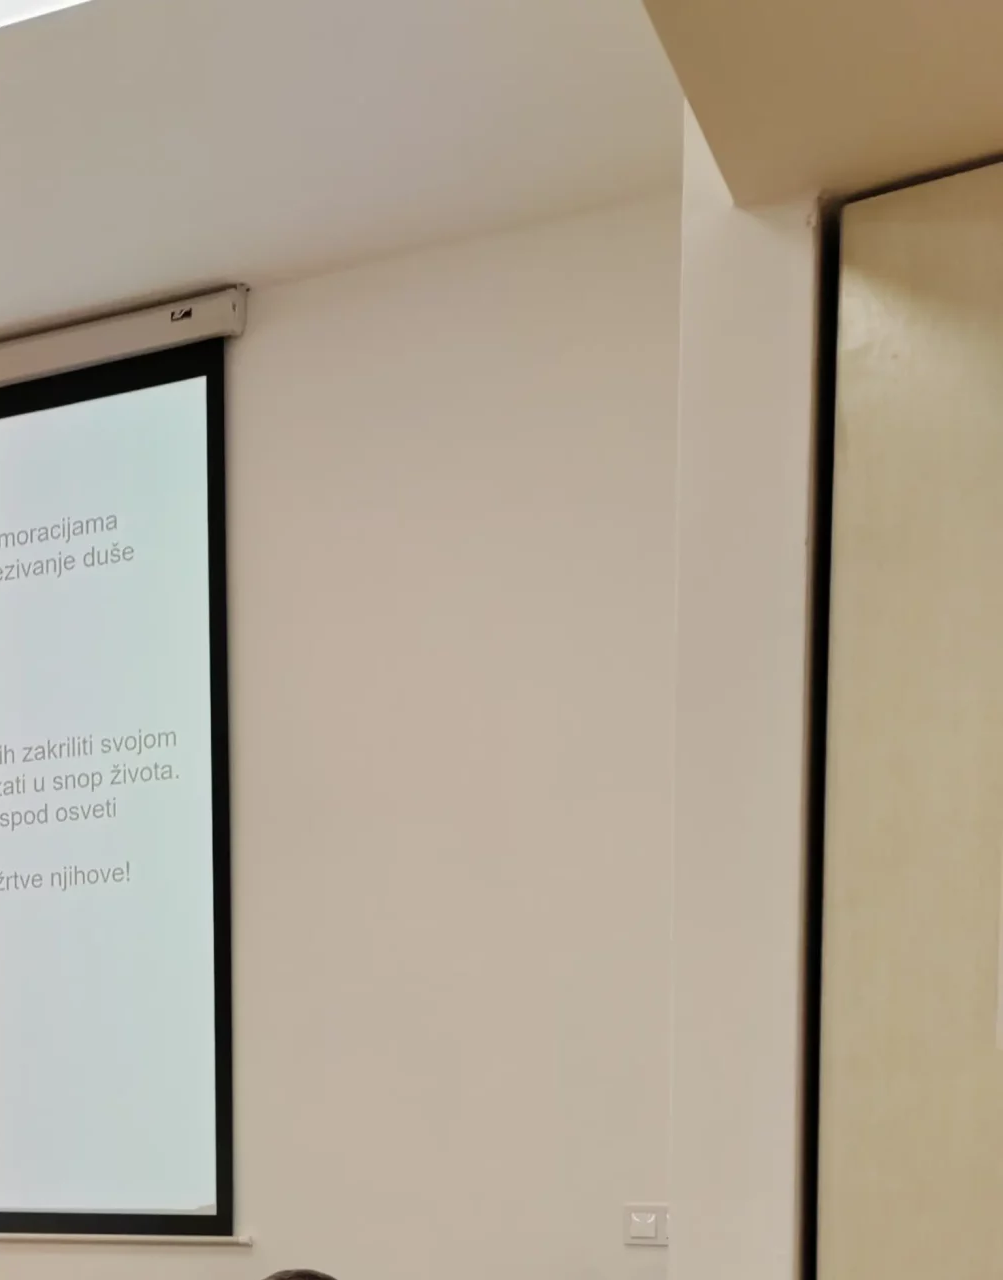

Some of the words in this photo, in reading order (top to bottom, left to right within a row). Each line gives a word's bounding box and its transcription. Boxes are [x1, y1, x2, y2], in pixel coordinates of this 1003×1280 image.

[83, 545, 134, 568] duše
[0, 746, 15, 765] ih
[22, 738, 93, 763] zakriliti
[100, 730, 177, 756] svojom
[33, 779, 45, 793] u
[52, 773, 103, 792] snop
[110, 764, 179, 786] života.
[55, 801, 116, 822] osveti
[50, 863, 130, 892] njihove!
